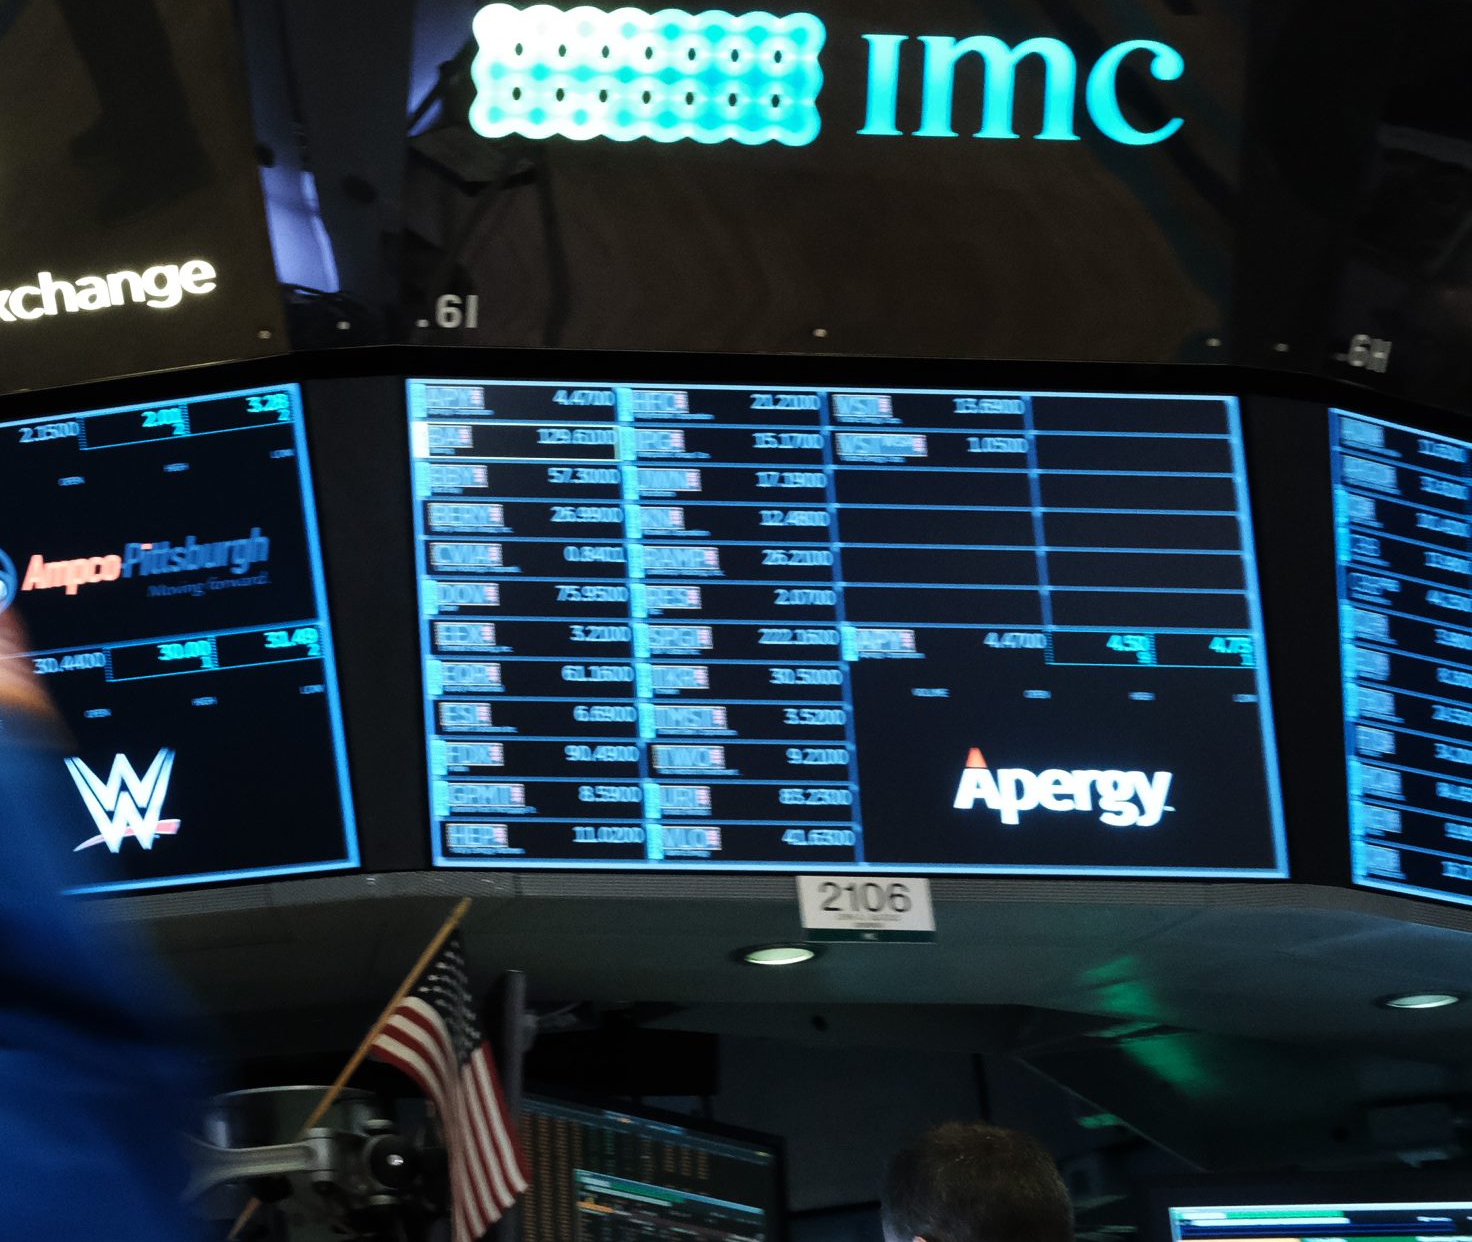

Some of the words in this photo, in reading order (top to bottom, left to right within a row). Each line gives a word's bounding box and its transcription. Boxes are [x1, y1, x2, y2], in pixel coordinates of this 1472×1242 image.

[21, 554, 123, 596] Ampco
[122, 527, 271, 579] Pittsburgh
[954, 747, 1175, 827] Apergy
[818, 881, 913, 913] 2106
